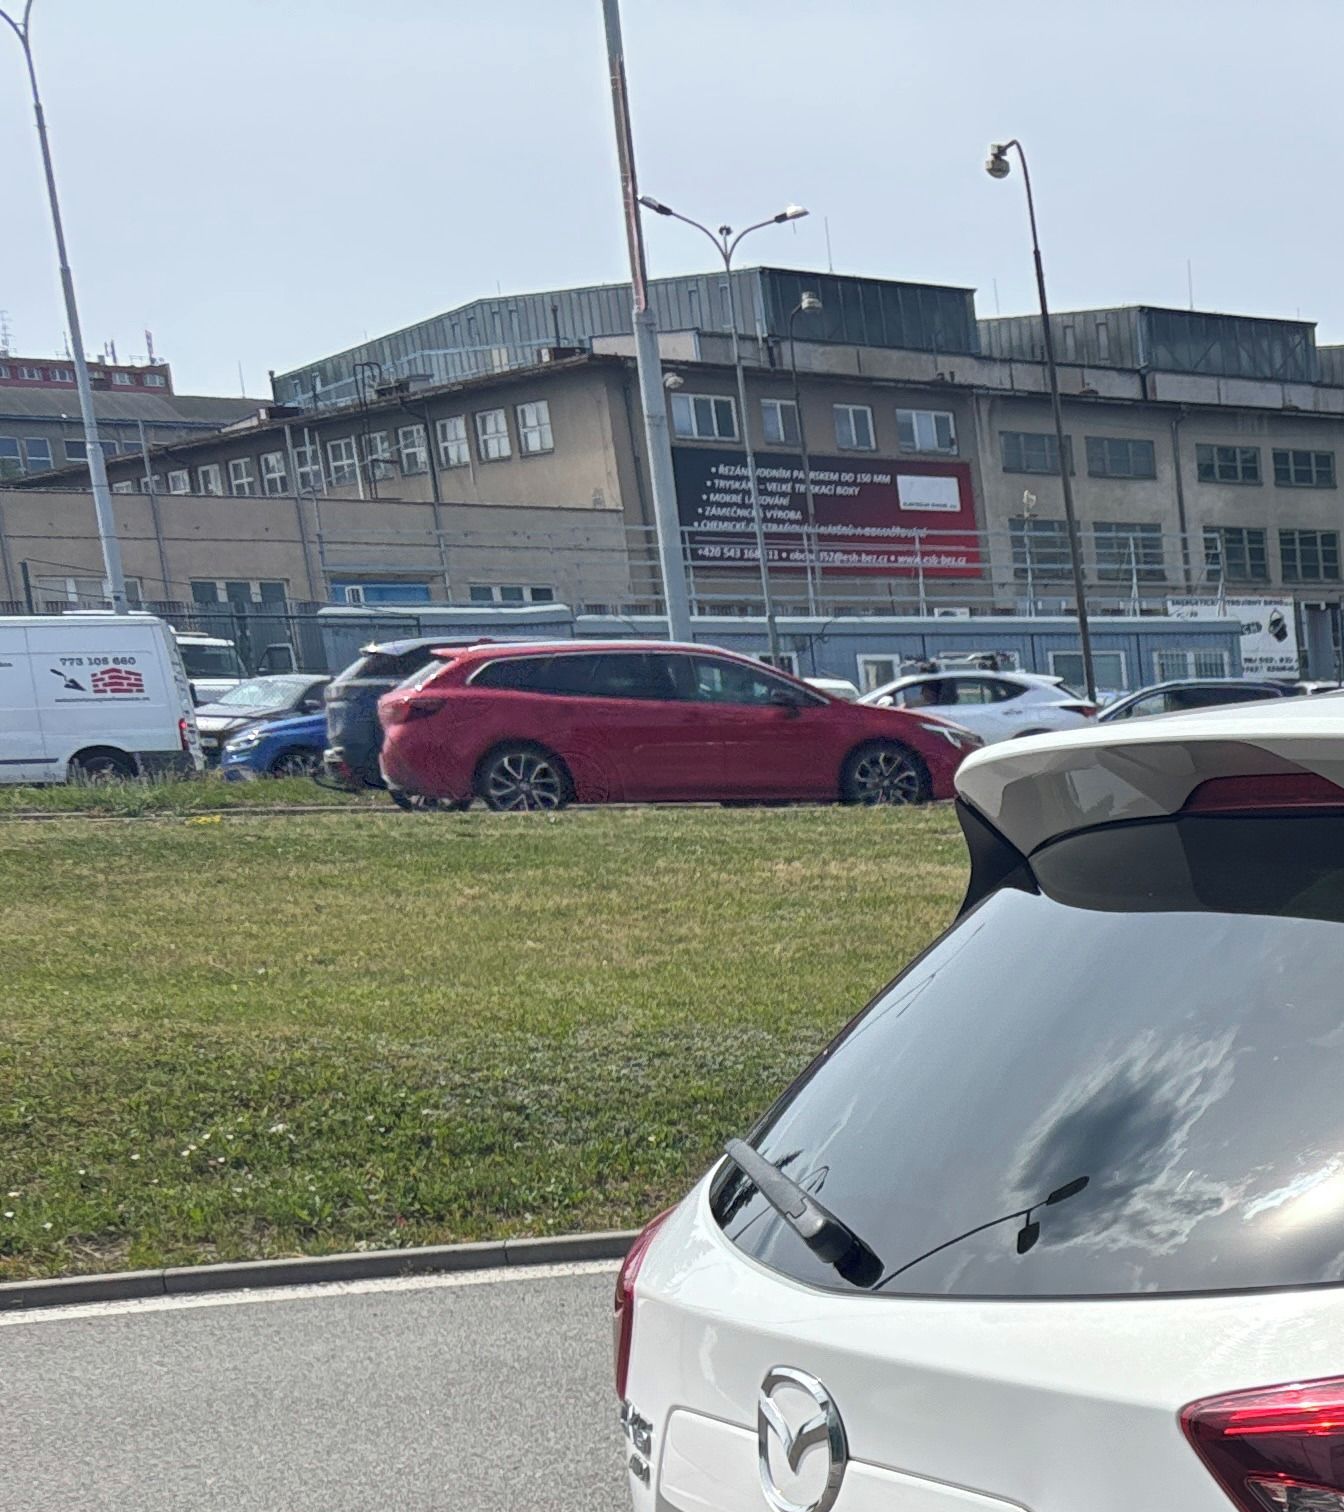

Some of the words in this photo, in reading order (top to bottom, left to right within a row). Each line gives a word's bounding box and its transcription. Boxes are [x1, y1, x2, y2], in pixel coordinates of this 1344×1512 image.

[718, 463, 751, 476] ŘEZÁN
[793, 470, 839, 481] PARSKEM
[841, 472, 854, 482] DO
[857, 473, 872, 483] 150
[873, 474, 891, 485] MM
[714, 479, 754, 491] TRYSKÁN
[795, 484, 834, 495] TRSKACÍ
[836, 486, 860, 496] BOXY
[709, 493, 742, 504] MOKRÉ
[766, 508, 802, 520] VÝROBA
[698, 546, 721, 558] +420
[723, 547, 741, 559] 543
